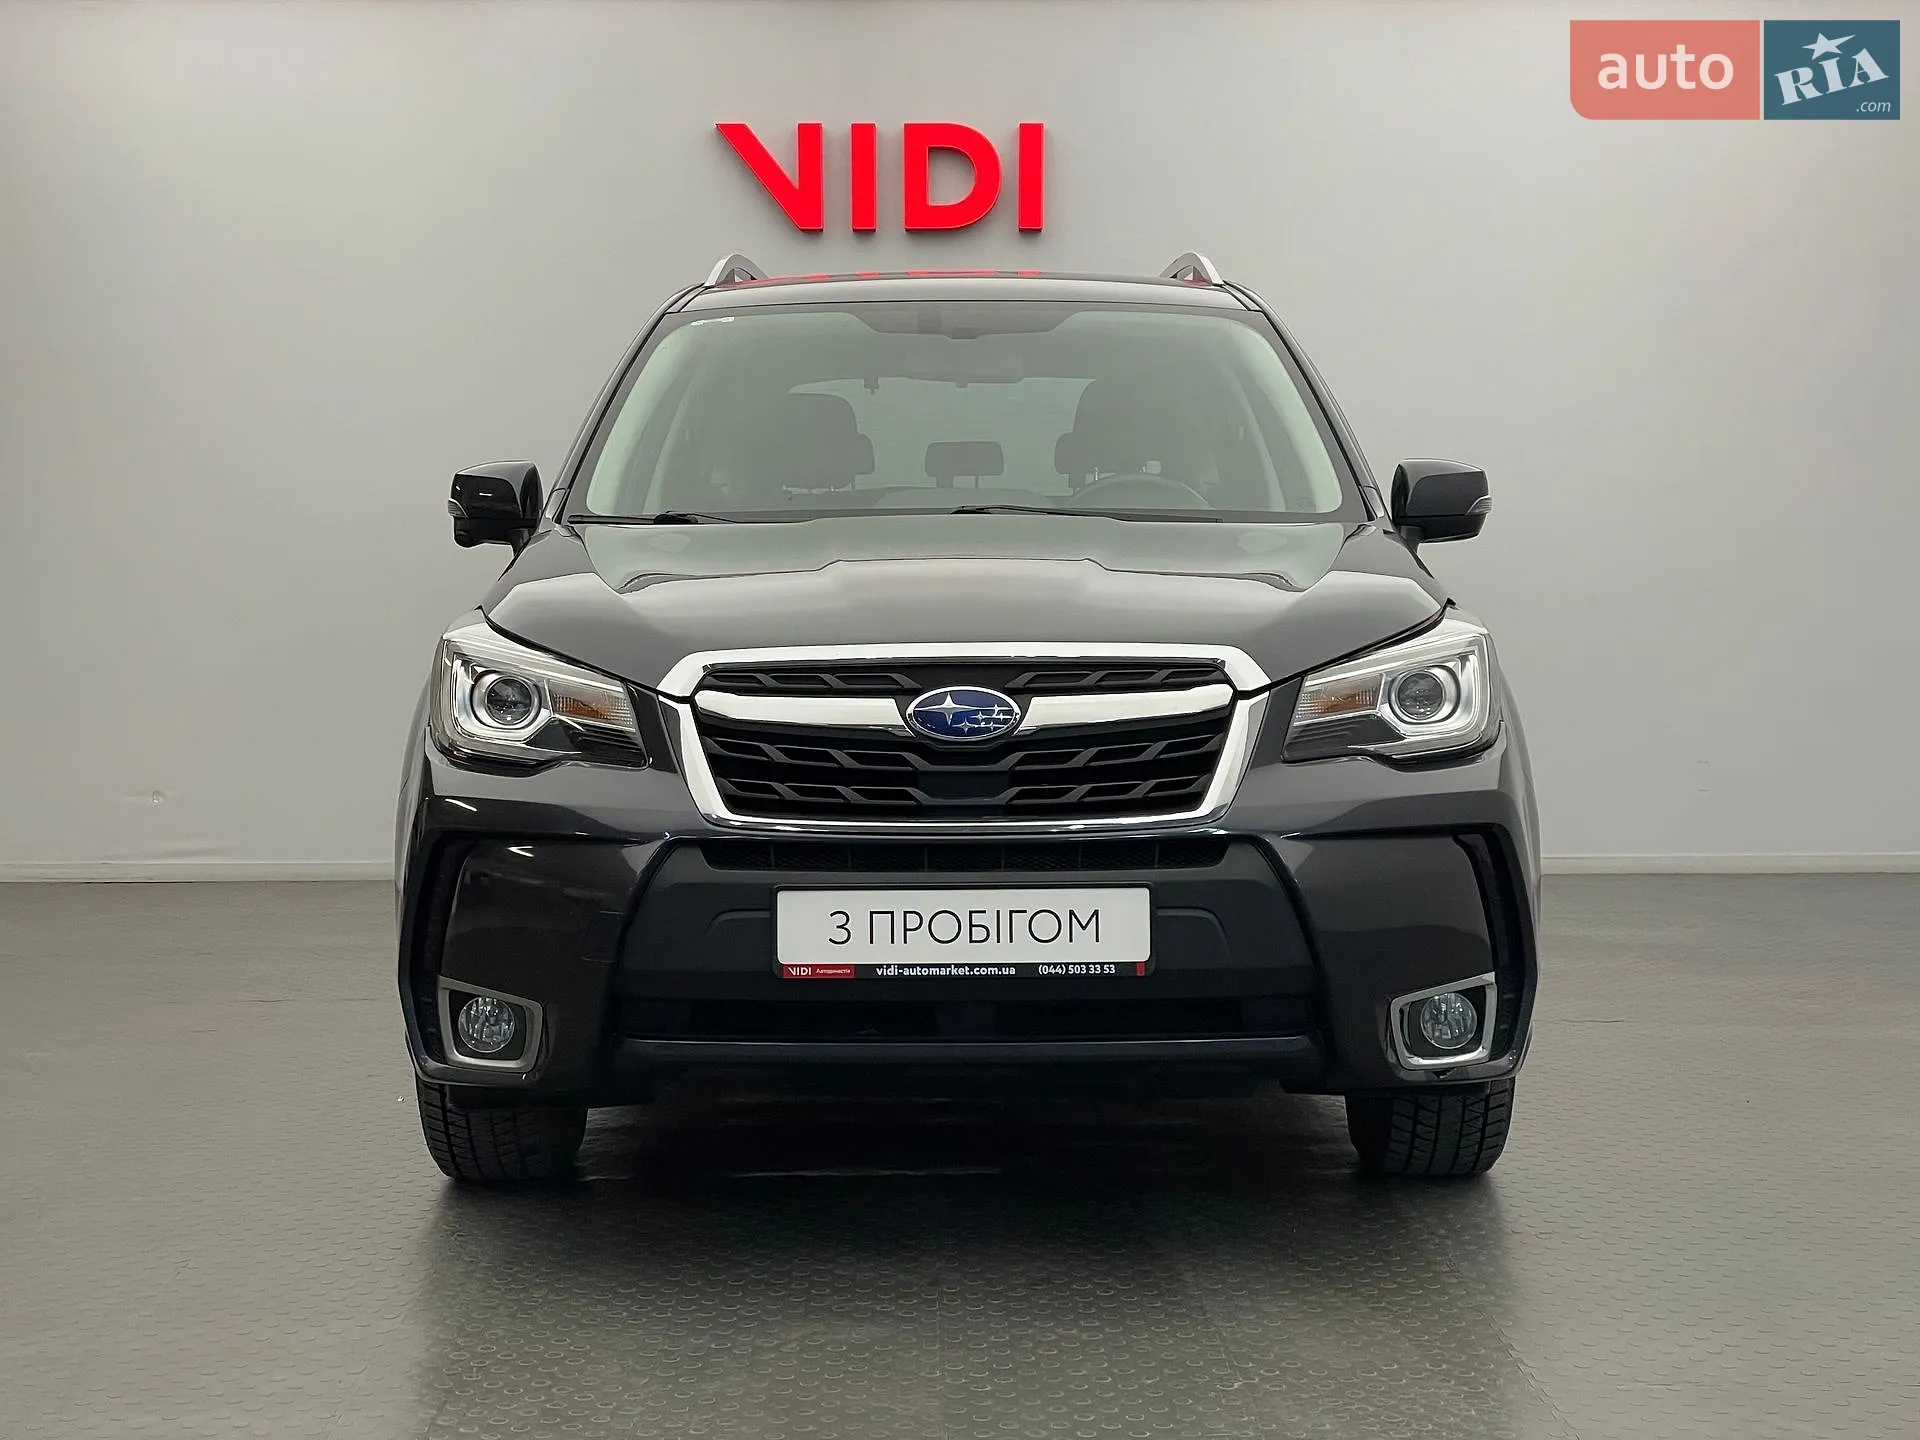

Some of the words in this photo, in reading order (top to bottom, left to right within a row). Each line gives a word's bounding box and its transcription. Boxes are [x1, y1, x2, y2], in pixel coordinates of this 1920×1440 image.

[715, 122, 1045, 232] VIDI
[869, 908, 1100, 945] ПРОБІГОМ
[788, 967, 812, 976] VIDI
[876, 964, 1016, 976] vidi-automarket.com.ua
[1038, 964, 1066, 975] (044)
[1068, 964, 1087, 974] 503
[1088, 964, 1101, 974] 33
[1103, 964, 1116, 974] 53
